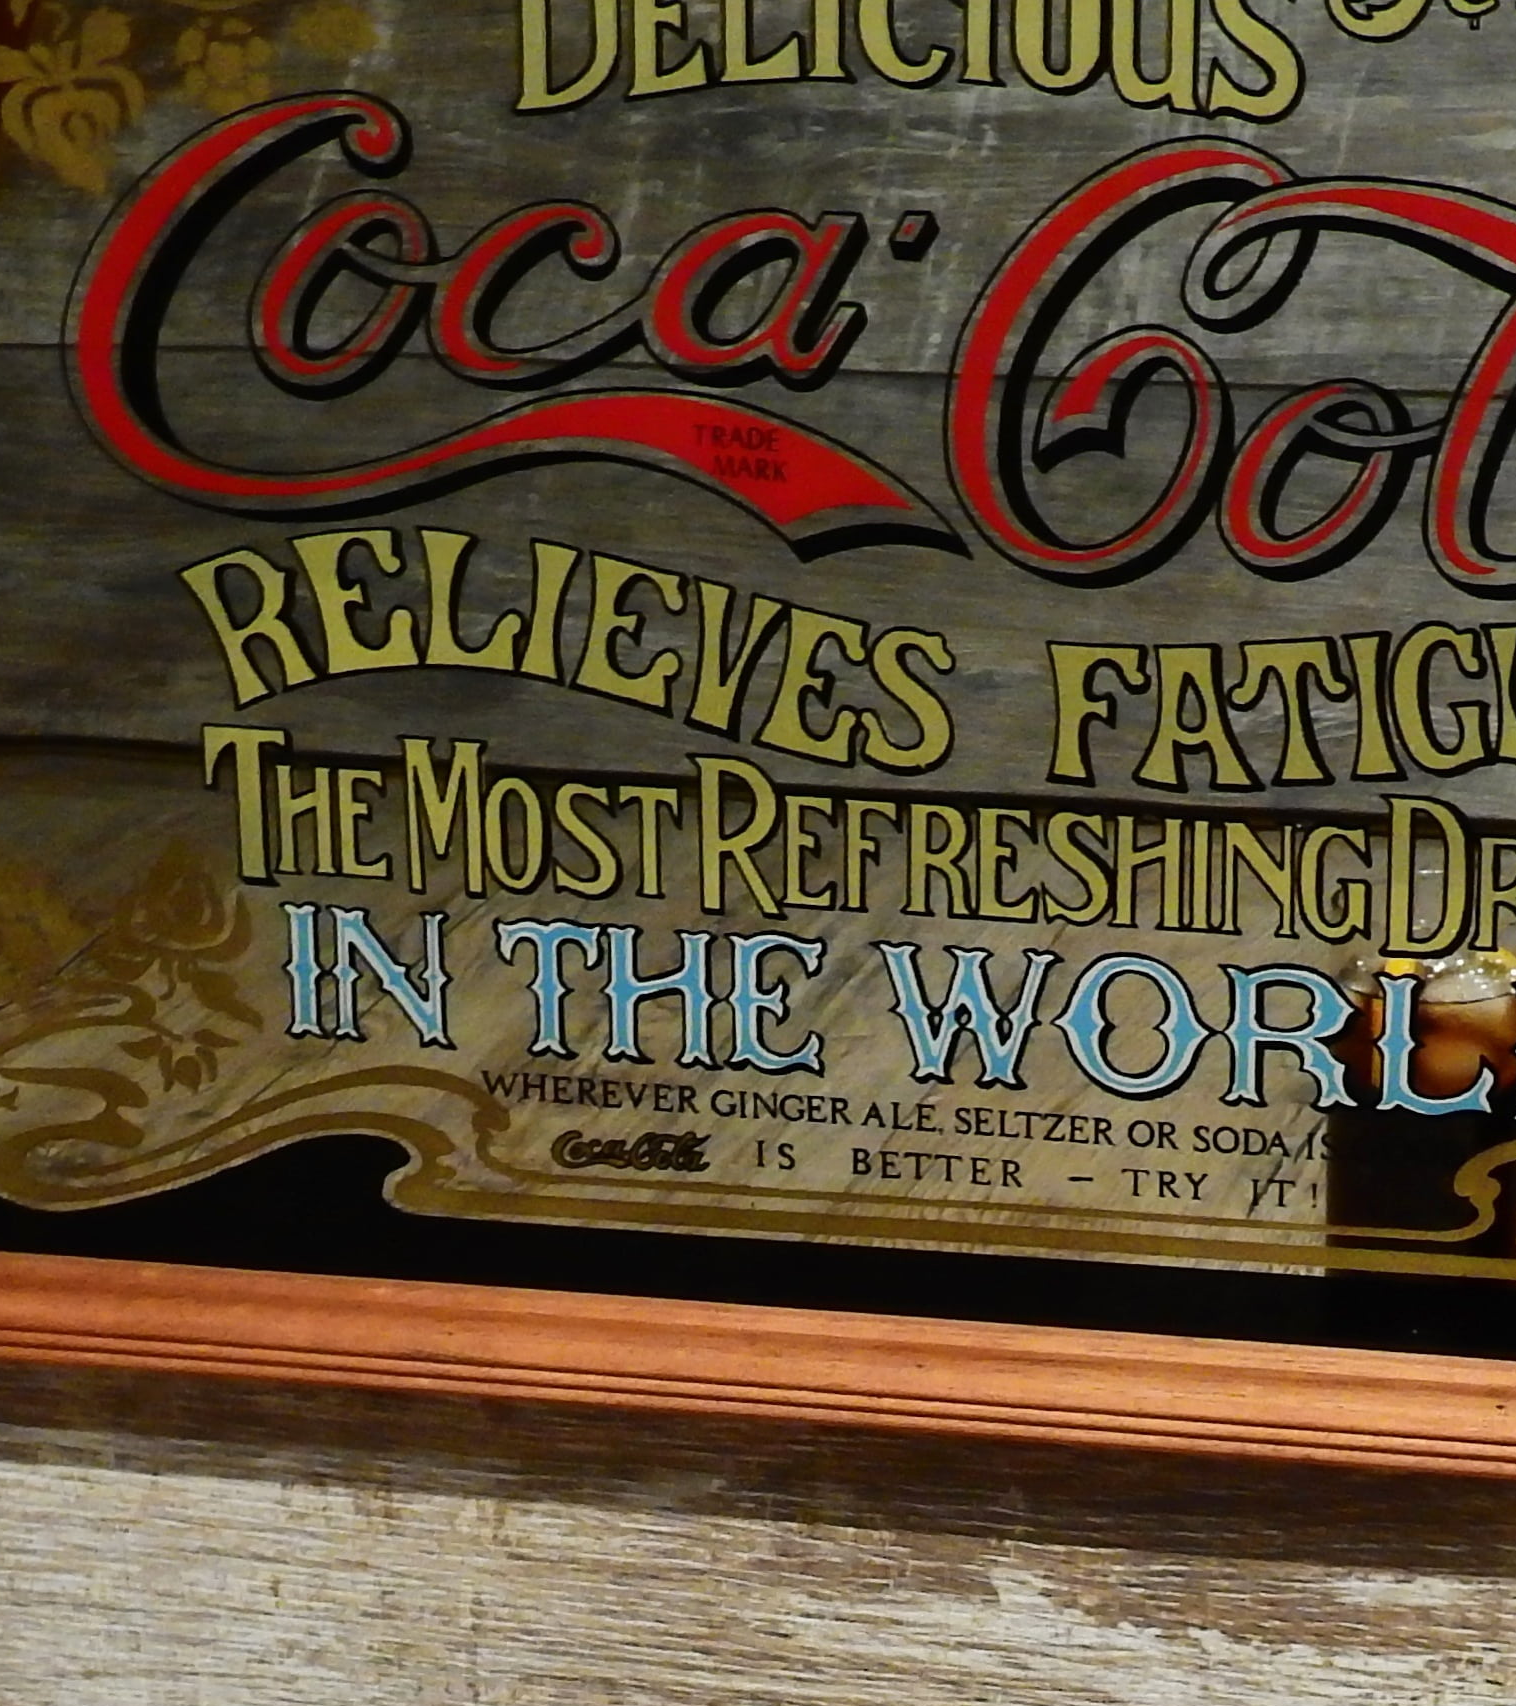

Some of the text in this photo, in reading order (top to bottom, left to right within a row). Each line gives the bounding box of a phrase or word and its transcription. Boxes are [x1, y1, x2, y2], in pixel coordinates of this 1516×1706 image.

[514, 0, 1305, 124] DELICIOUS
[691, 423, 780, 452] TRADE
[713, 455, 787, 483] MARK
[179, 525, 956, 776] RELIEVES
[282, 903, 457, 1050] IN
[494, 918, 826, 1076] THE
[482, 1069, 700, 1115] WHEREVER
[710, 1089, 853, 1127] GINGER
[860, 1100, 945, 1136] ALE,
[954, 1106, 1115, 1146] SELTZER
[1127, 1119, 1179, 1150] OR
[1192, 1125, 1291, 1158] SODA
[756, 1140, 796, 1170] IS
[851, 1147, 1023, 1188] BETTER
[1121, 1168, 1209, 1200] TRY
